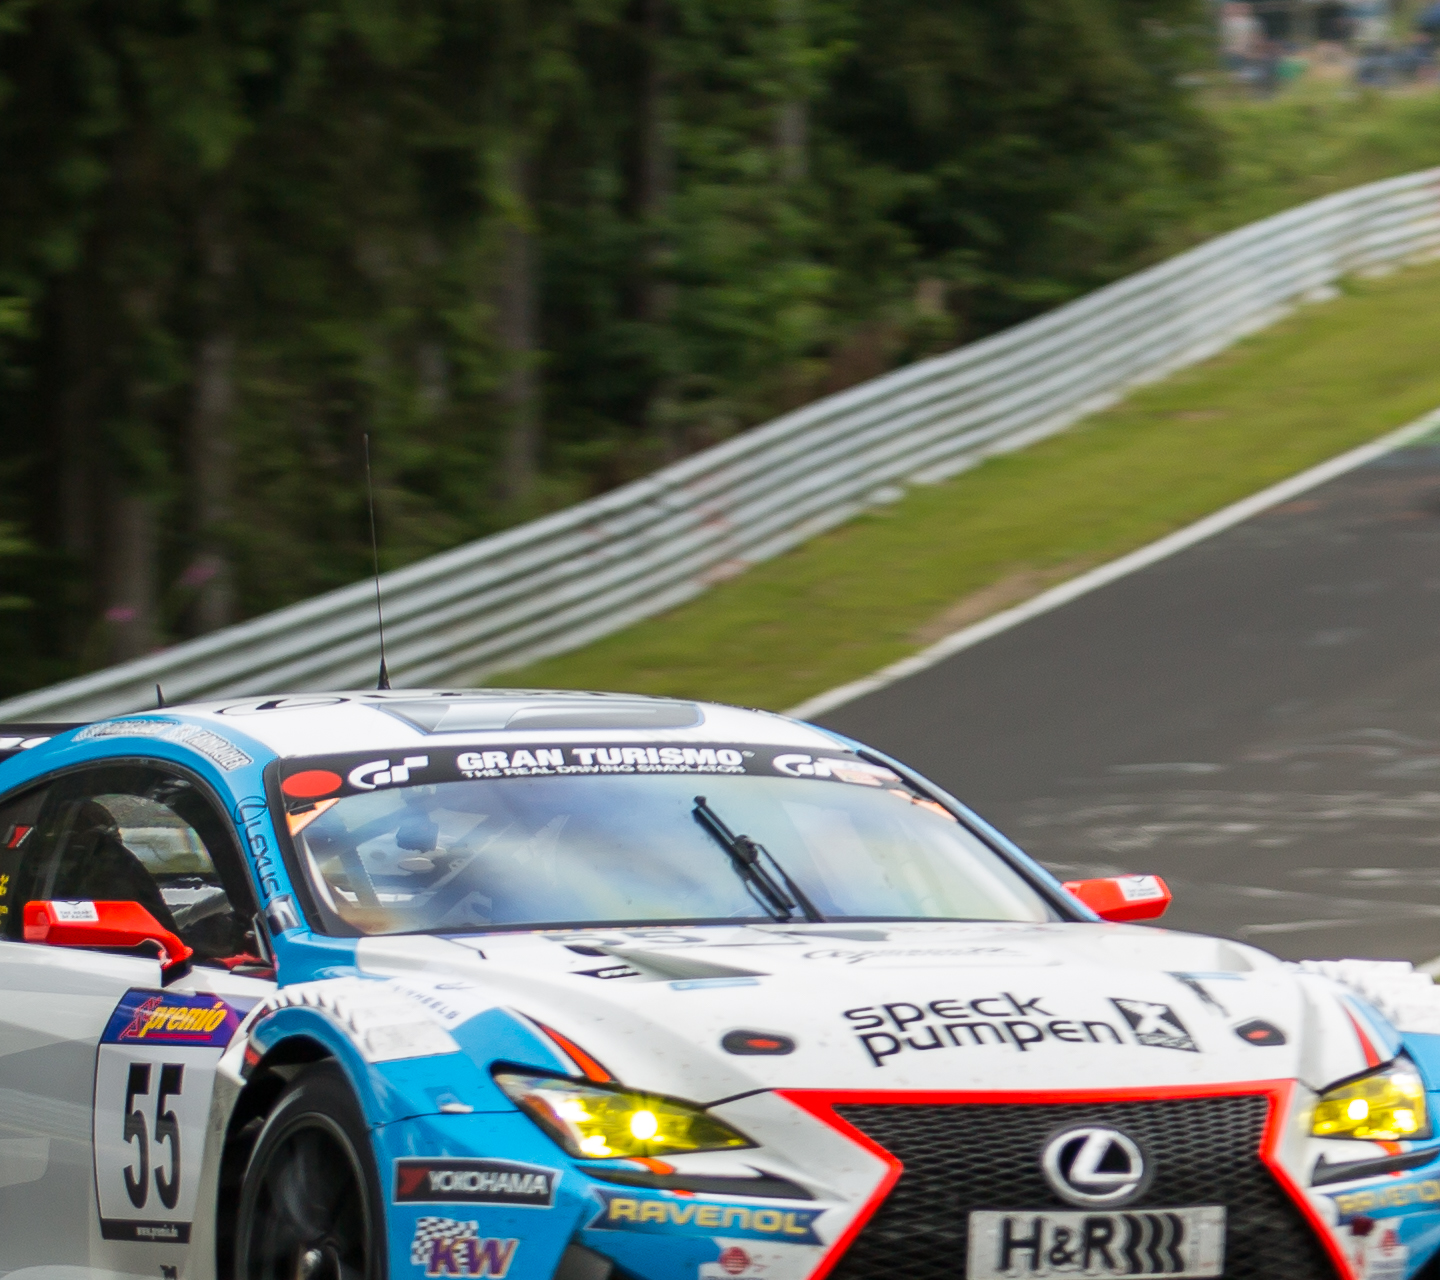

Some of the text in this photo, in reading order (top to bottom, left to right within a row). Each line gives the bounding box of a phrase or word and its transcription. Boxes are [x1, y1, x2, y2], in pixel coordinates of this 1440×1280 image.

[457, 747, 744, 771] GRAN TURISMO
[461, 764, 747, 779] THE REAL DRIVING SIMULATOR
[245, 820, 281, 900] LEXUS
[138, 1001, 228, 1038] premio
[843, 991, 1058, 1033] speck
[857, 1019, 1127, 1068] pumpen
[122, 1062, 186, 1210] 55
[428, 1170, 549, 1195] YOKOHAMA
[610, 1197, 809, 1235] RAVENOL
[423, 1237, 520, 1280] KW
[998, 1217, 1119, 1271] H&R
